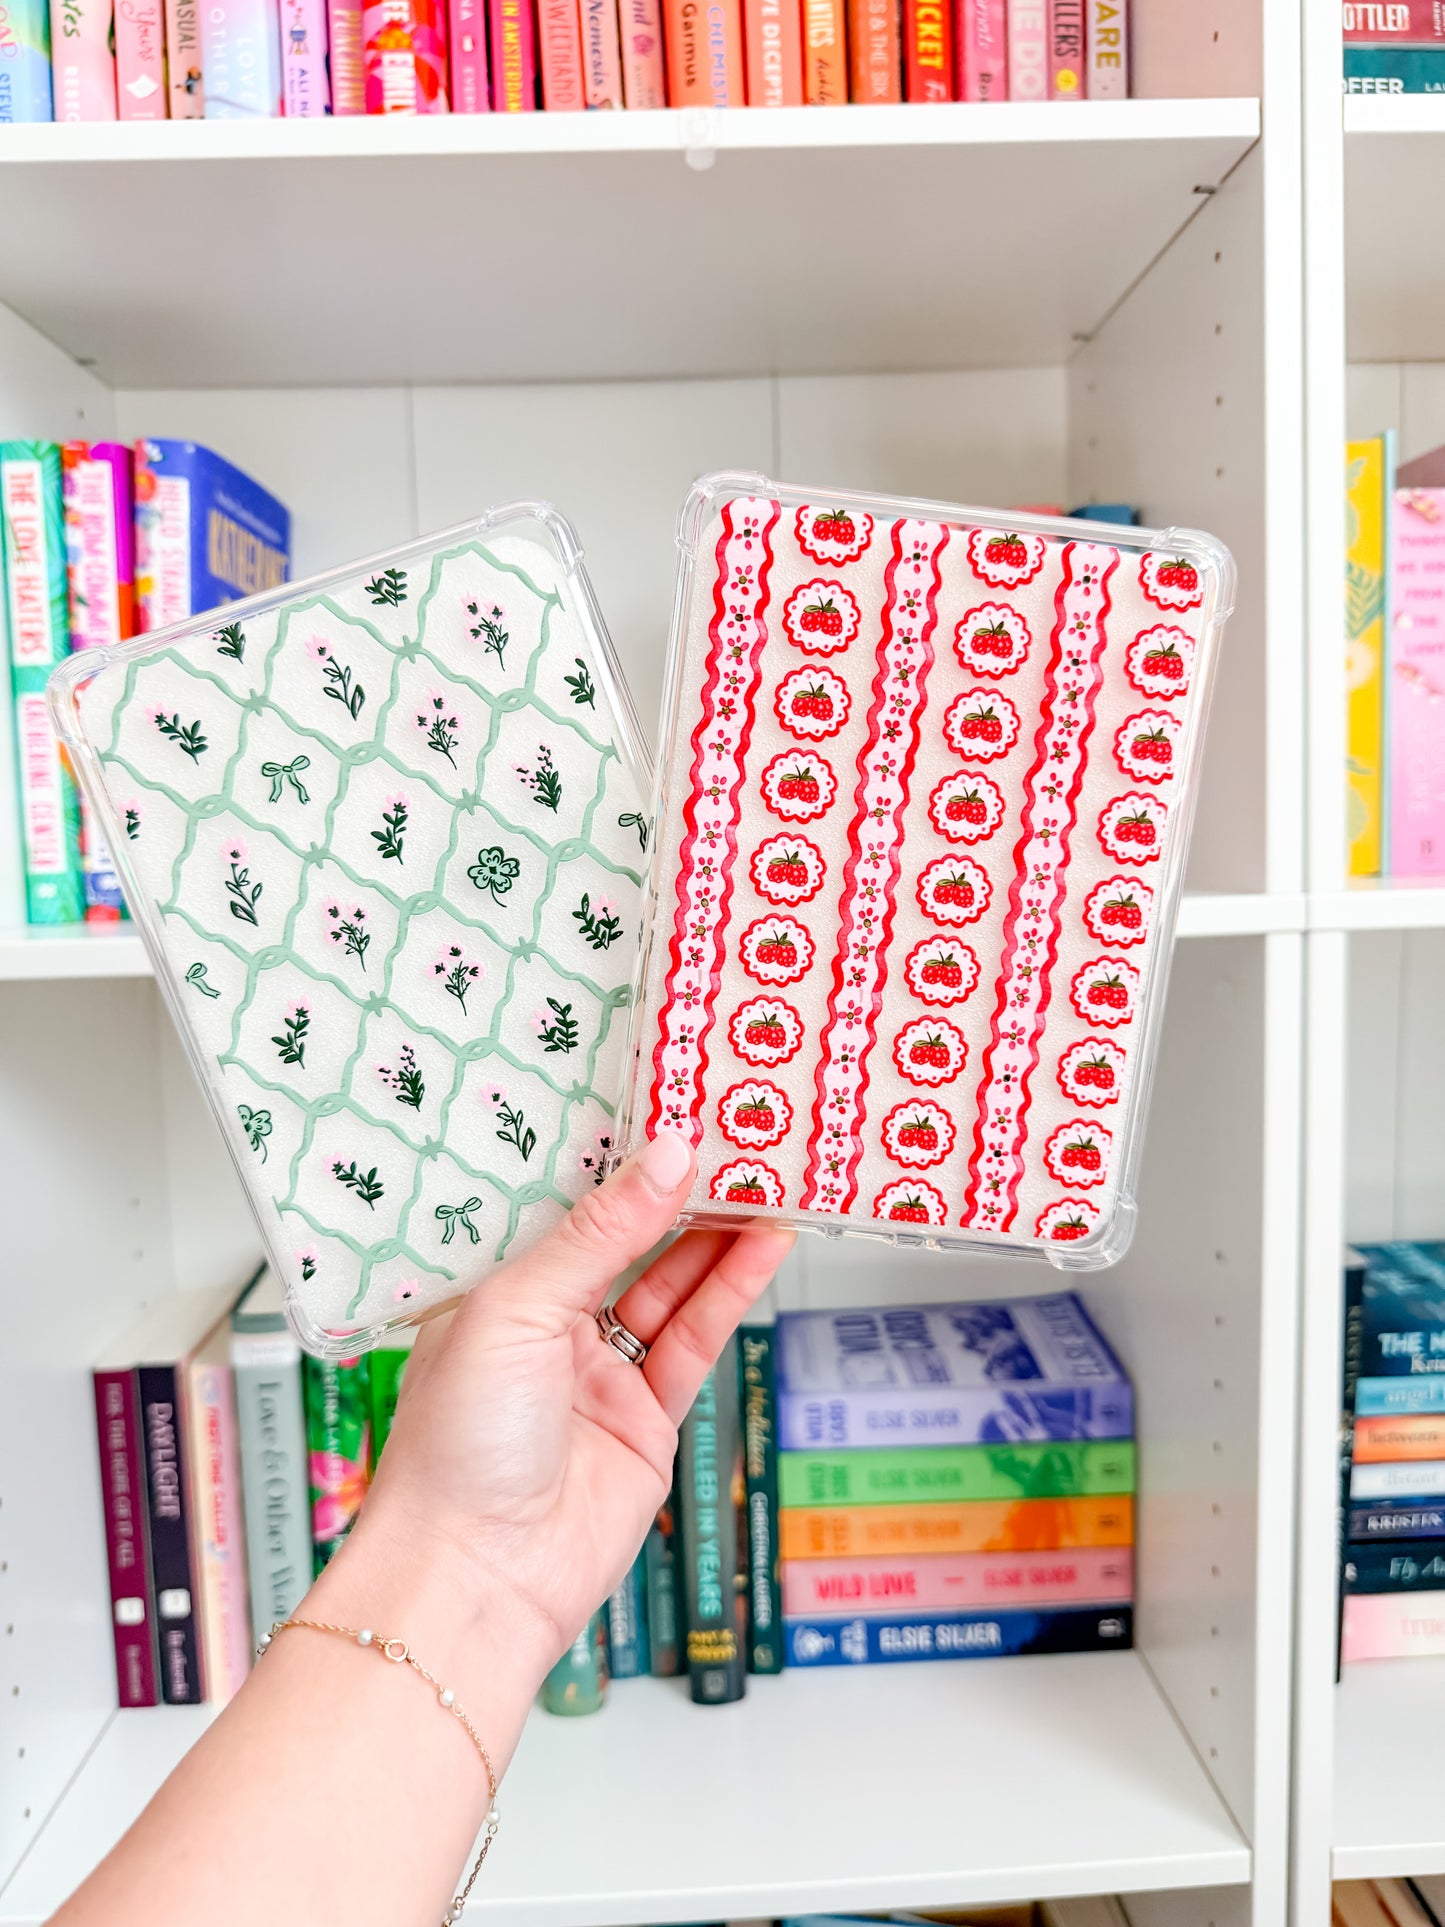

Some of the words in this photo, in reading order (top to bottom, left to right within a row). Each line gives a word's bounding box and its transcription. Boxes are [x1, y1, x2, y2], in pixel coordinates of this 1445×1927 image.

[208, 7, 230, 95] OTHER
[682, 3, 698, 87] Garmus
[807, 0, 836, 48] NTICS
[1053, 0, 1081, 58] ILLERS
[1096, 0, 1122, 69] ARE
[235, 37, 257, 103] LOVE
[10, 472, 37, 506] THE
[13, 515, 42, 564] LOVE
[15, 574, 48, 656] HATERS
[1377, 1331, 1424, 1358] THE
[256, 1381, 284, 1441] Love
[147, 1402, 181, 1519] DAYLIGHT
[693, 1420, 719, 1504] KILLED
[263, 1476, 293, 1557] Other
[696, 1508, 719, 1536] IN
[697, 1537, 723, 1618] YEARS
[814, 1573, 865, 1602] WILD
[868, 1571, 916, 1598] LOVE
[878, 1625, 933, 1656] ELSIE
[935, 1621, 1001, 1652] SILVER
